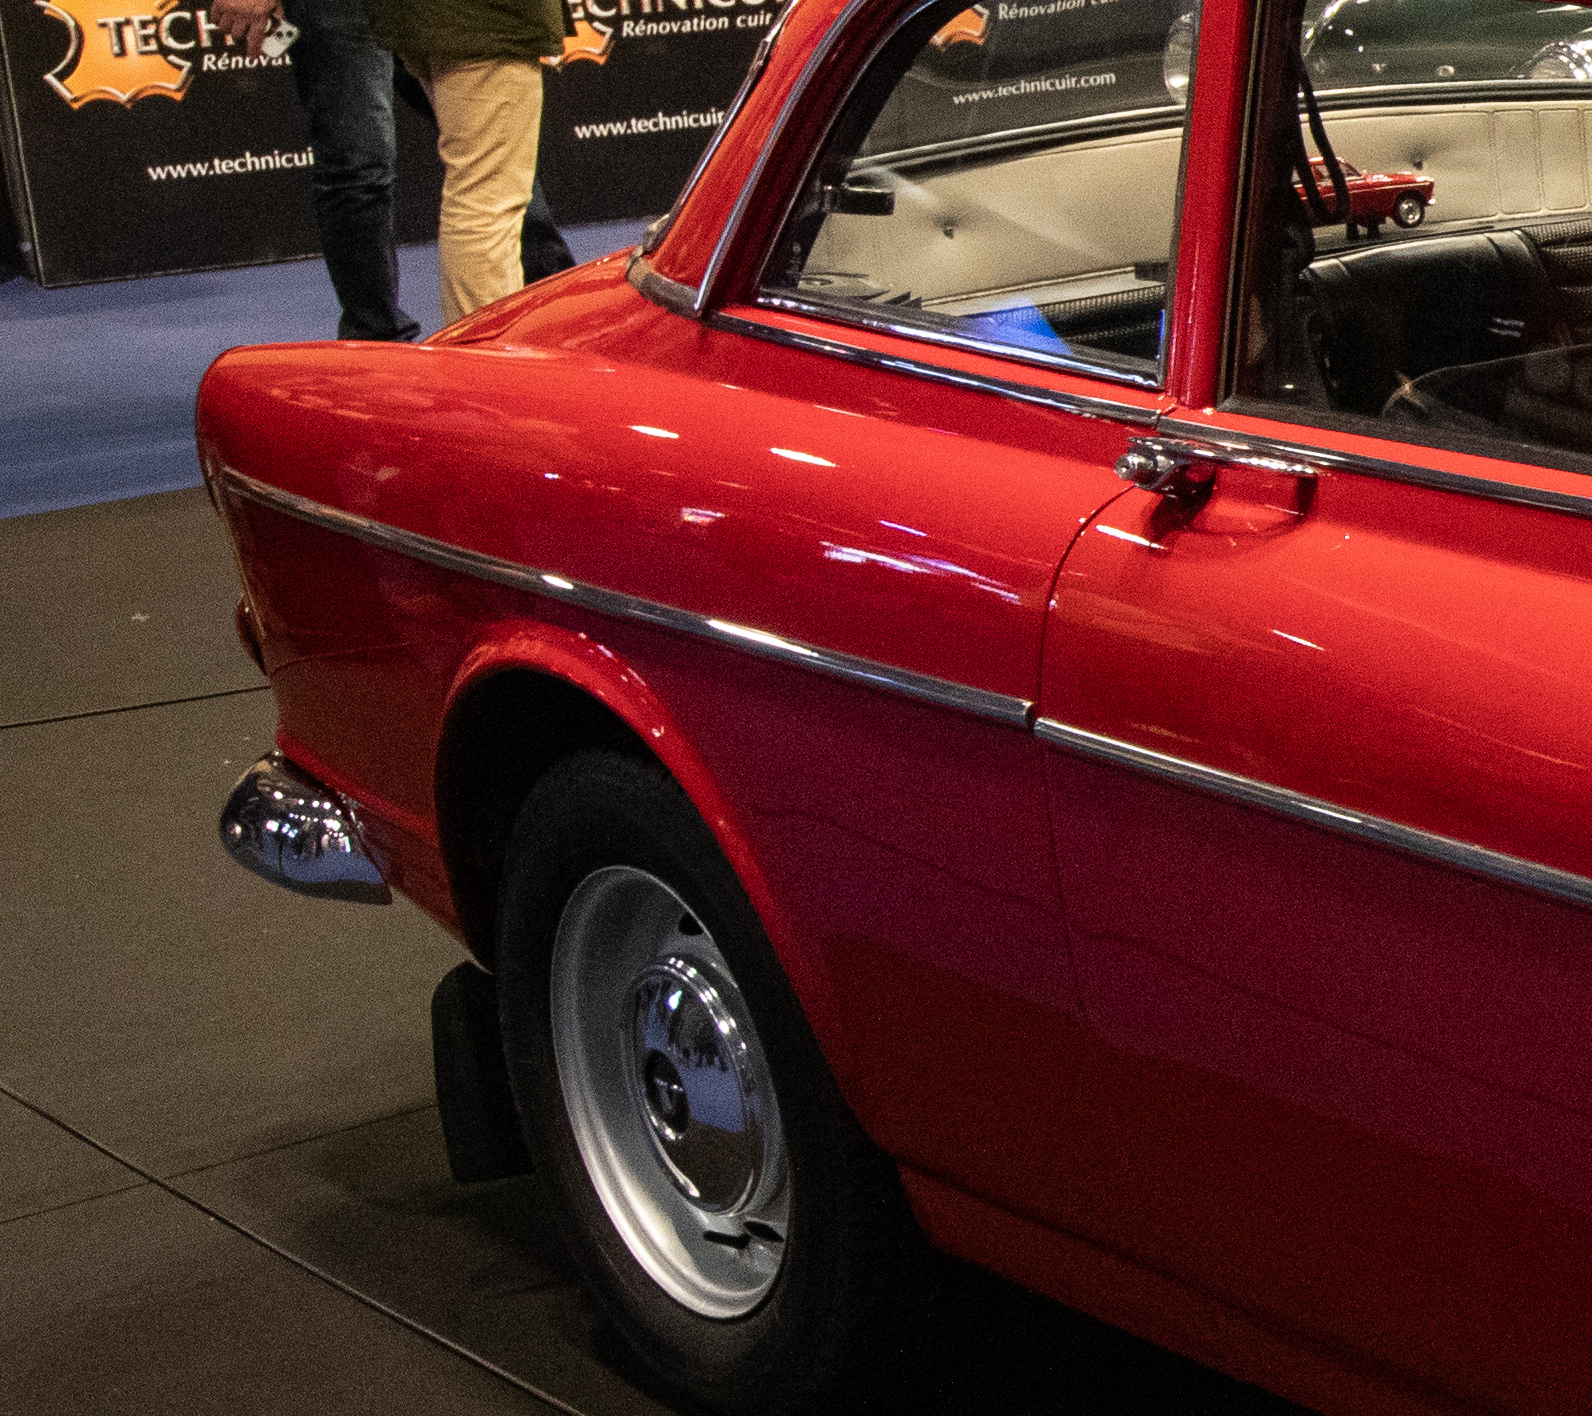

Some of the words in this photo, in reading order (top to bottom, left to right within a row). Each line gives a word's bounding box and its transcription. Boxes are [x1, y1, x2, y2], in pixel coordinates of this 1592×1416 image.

[622, 15, 730, 38] Rénovation
[735, 10, 773, 28] cuir
[952, 71, 1116, 105] www.technicuir.com
[574, 108, 725, 139] www.technicuir
[147, 147, 316, 181] www.technicui
